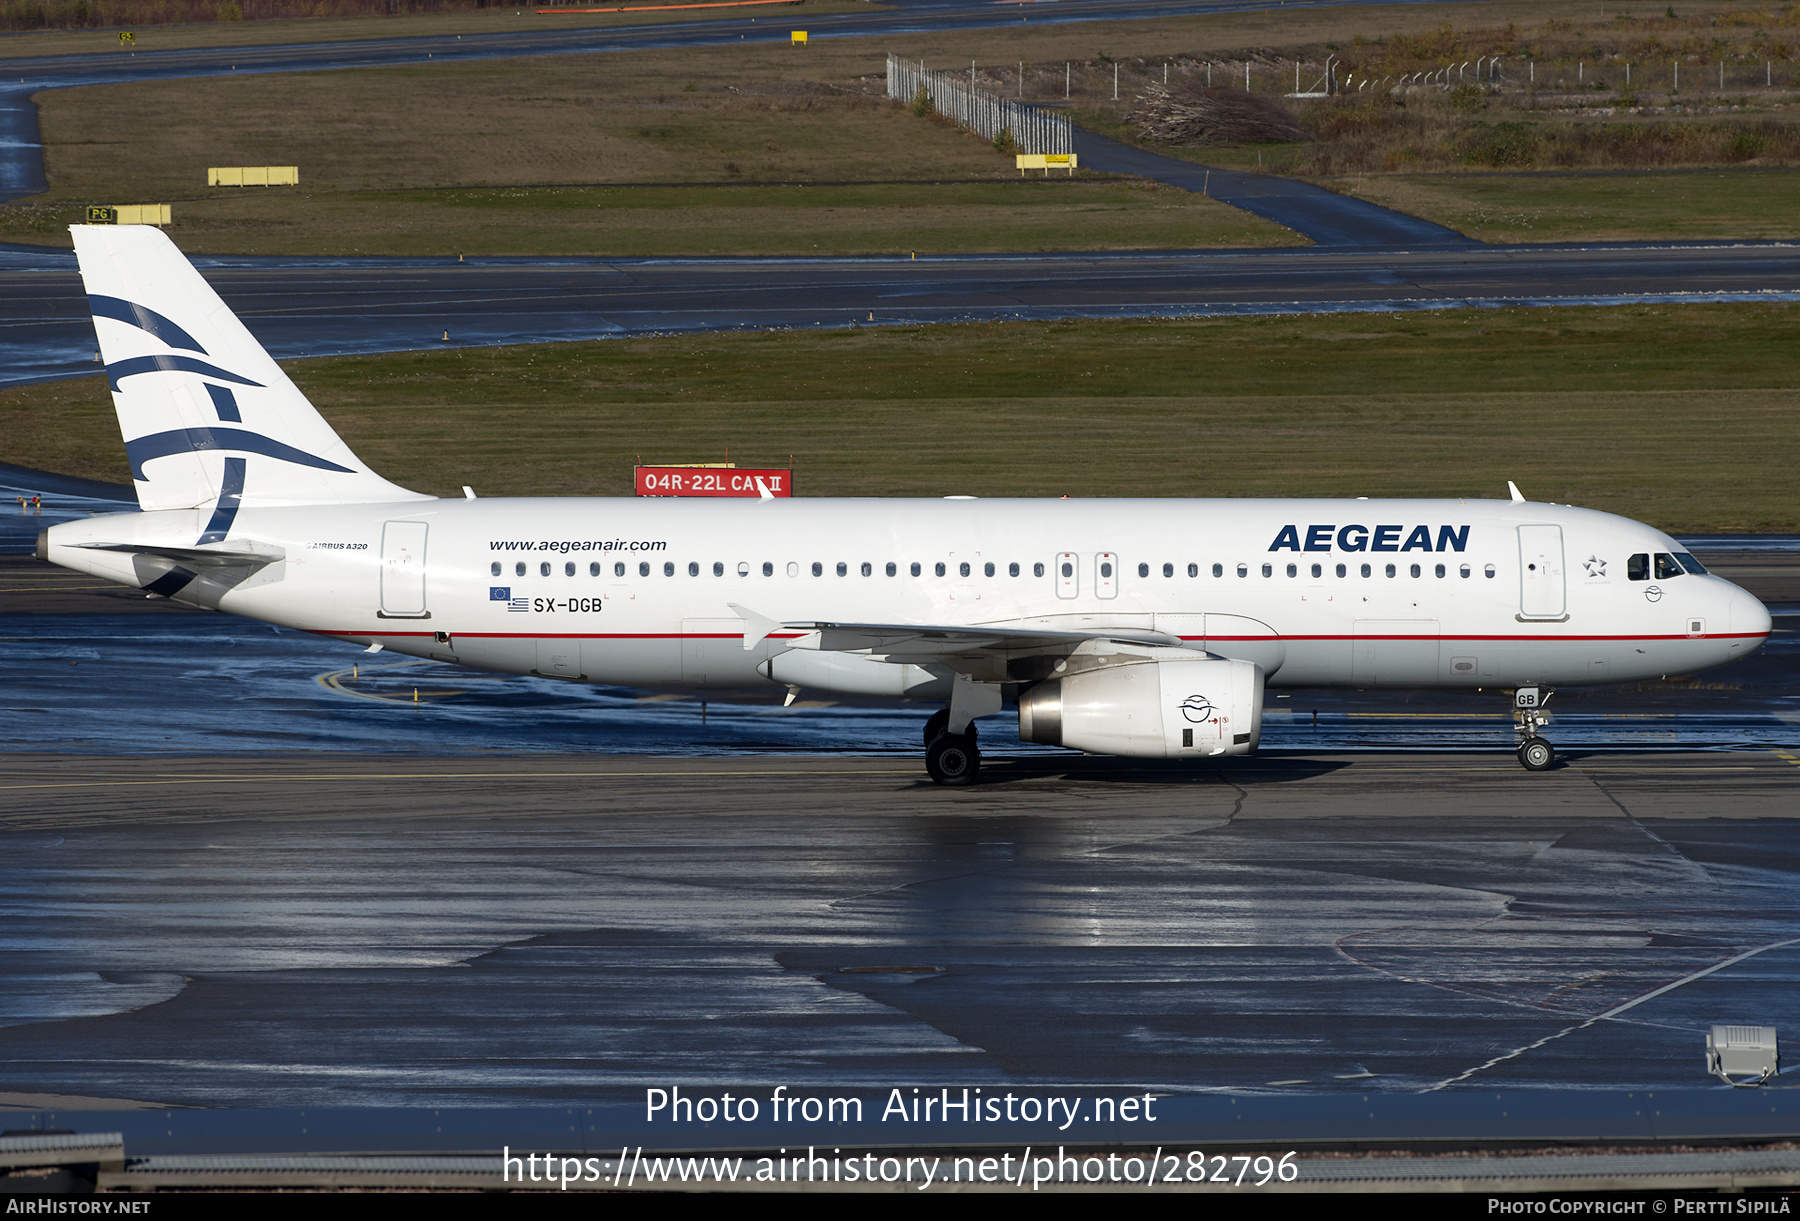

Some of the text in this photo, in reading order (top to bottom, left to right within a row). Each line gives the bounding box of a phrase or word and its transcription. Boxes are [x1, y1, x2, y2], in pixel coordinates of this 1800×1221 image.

[92, 208, 108, 219] PG
[645, 474, 726, 491] 04R-22L
[312, 542, 345, 550] AIRBUS
[489, 538, 667, 554] www.aegeanair.com
[1267, 524, 1471, 552] AEGEAN
[533, 597, 602, 613] SX-DGB
[1518, 694, 1535, 705] GB
